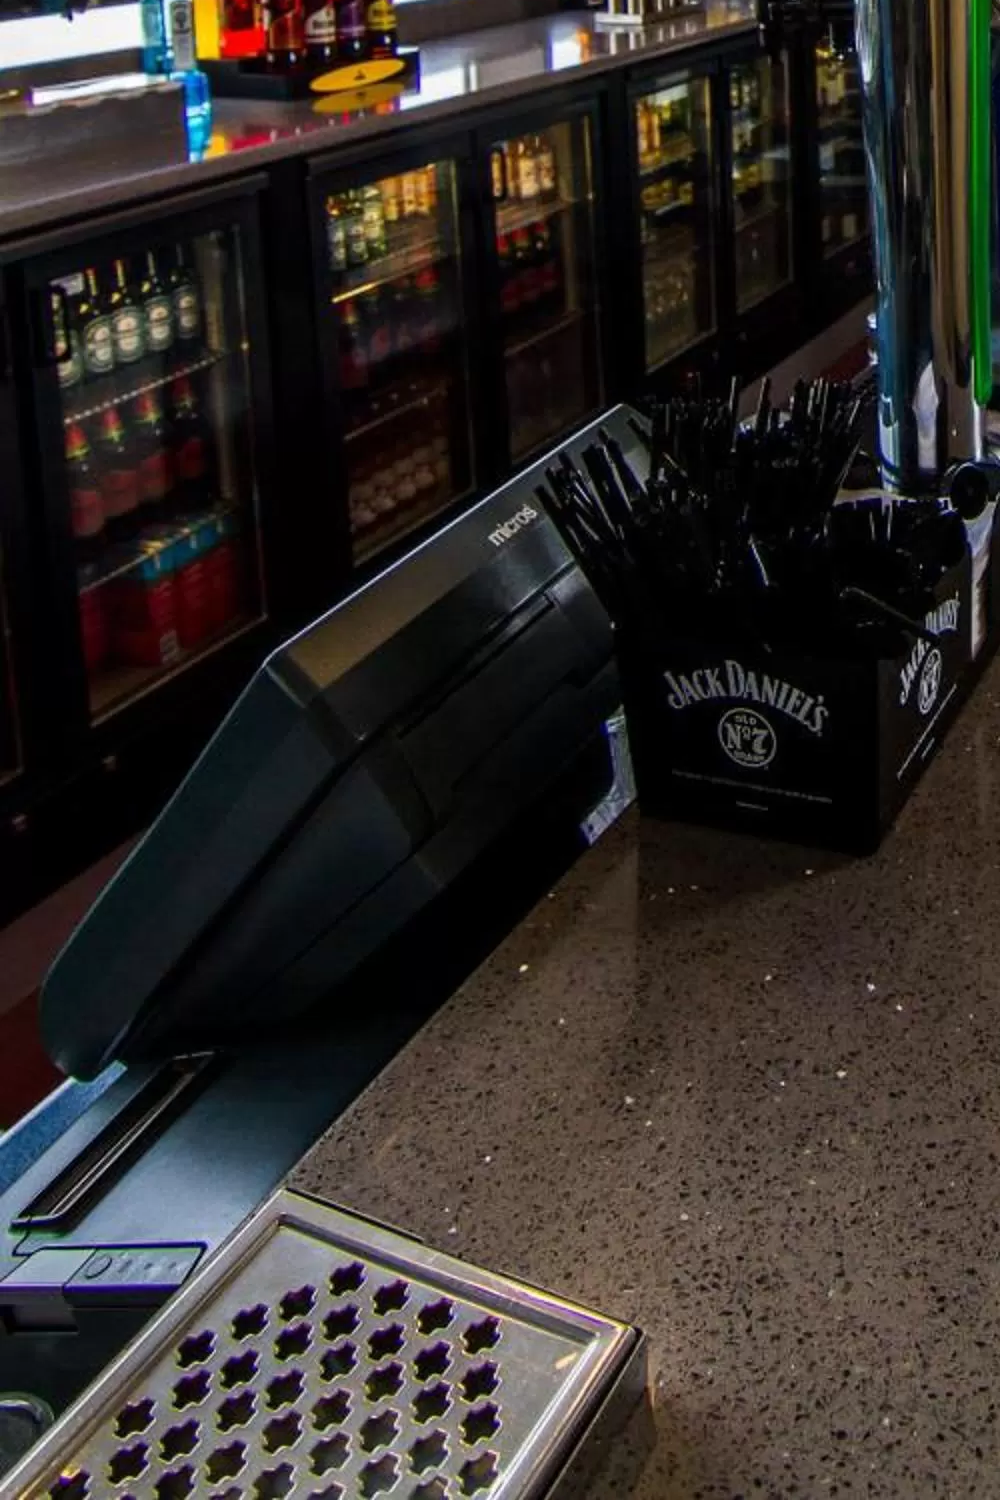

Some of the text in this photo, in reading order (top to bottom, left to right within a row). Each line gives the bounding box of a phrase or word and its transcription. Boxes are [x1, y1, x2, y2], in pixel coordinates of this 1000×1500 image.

[488, 504, 538, 548] micros
[663, 666, 727, 710] JACK
[724, 659, 830, 733] DANIEL'S
